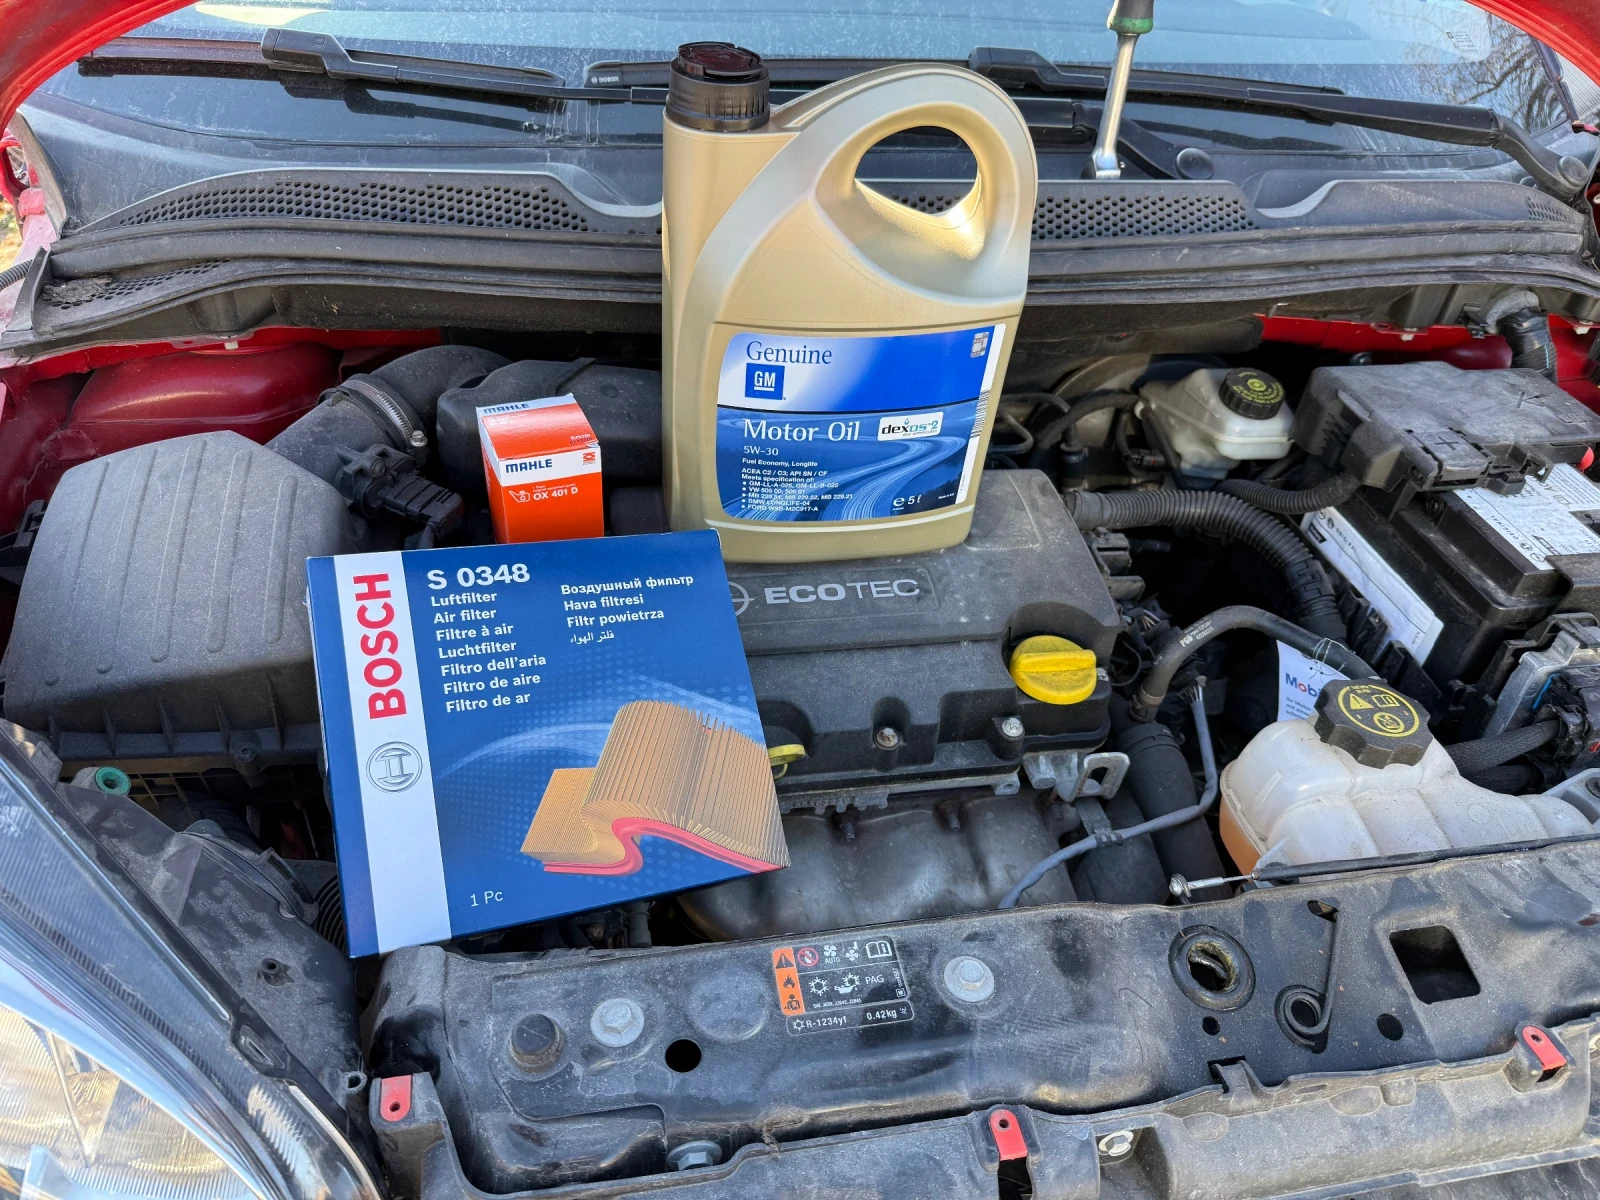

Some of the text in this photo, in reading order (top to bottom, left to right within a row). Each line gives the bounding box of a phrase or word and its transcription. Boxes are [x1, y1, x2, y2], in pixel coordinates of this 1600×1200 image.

[746, 340, 832, 364] Genuine
[754, 370, 776, 388] GM
[484, 402, 530, 414] MAHLE
[743, 418, 860, 442] Motor Oil
[744, 445, 779, 456] 5W-30
[506, 458, 553, 474] MAHLE
[758, 459, 790, 468] Economy,
[532, 486, 578, 501] OX 401 D
[427, 563, 531, 590] S 0348
[560, 575, 694, 595] Воздушный фильтр
[430, 590, 498, 608] Luftfilter
[764, 578, 920, 605] ECOTEC
[563, 594, 644, 611] Hava filtresi
[434, 607, 497, 624] Air filter
[566, 608, 665, 627] Filtr powietrza
[436, 622, 514, 641] Filtre à air
[570, 630, 615, 645] فلتر الهواء
[352, 572, 407, 720] BOSCH
[438, 640, 517, 659] Luchtfilter
[440, 660, 483, 676] Filtro
[443, 673, 542, 695] Filtro de aire
[445, 692, 531, 713] Filtro de ar
[470, 889, 504, 907] 1 Pc
[865, 975, 884, 984] PAG
[866, 1009, 898, 1020] 0.42kg
